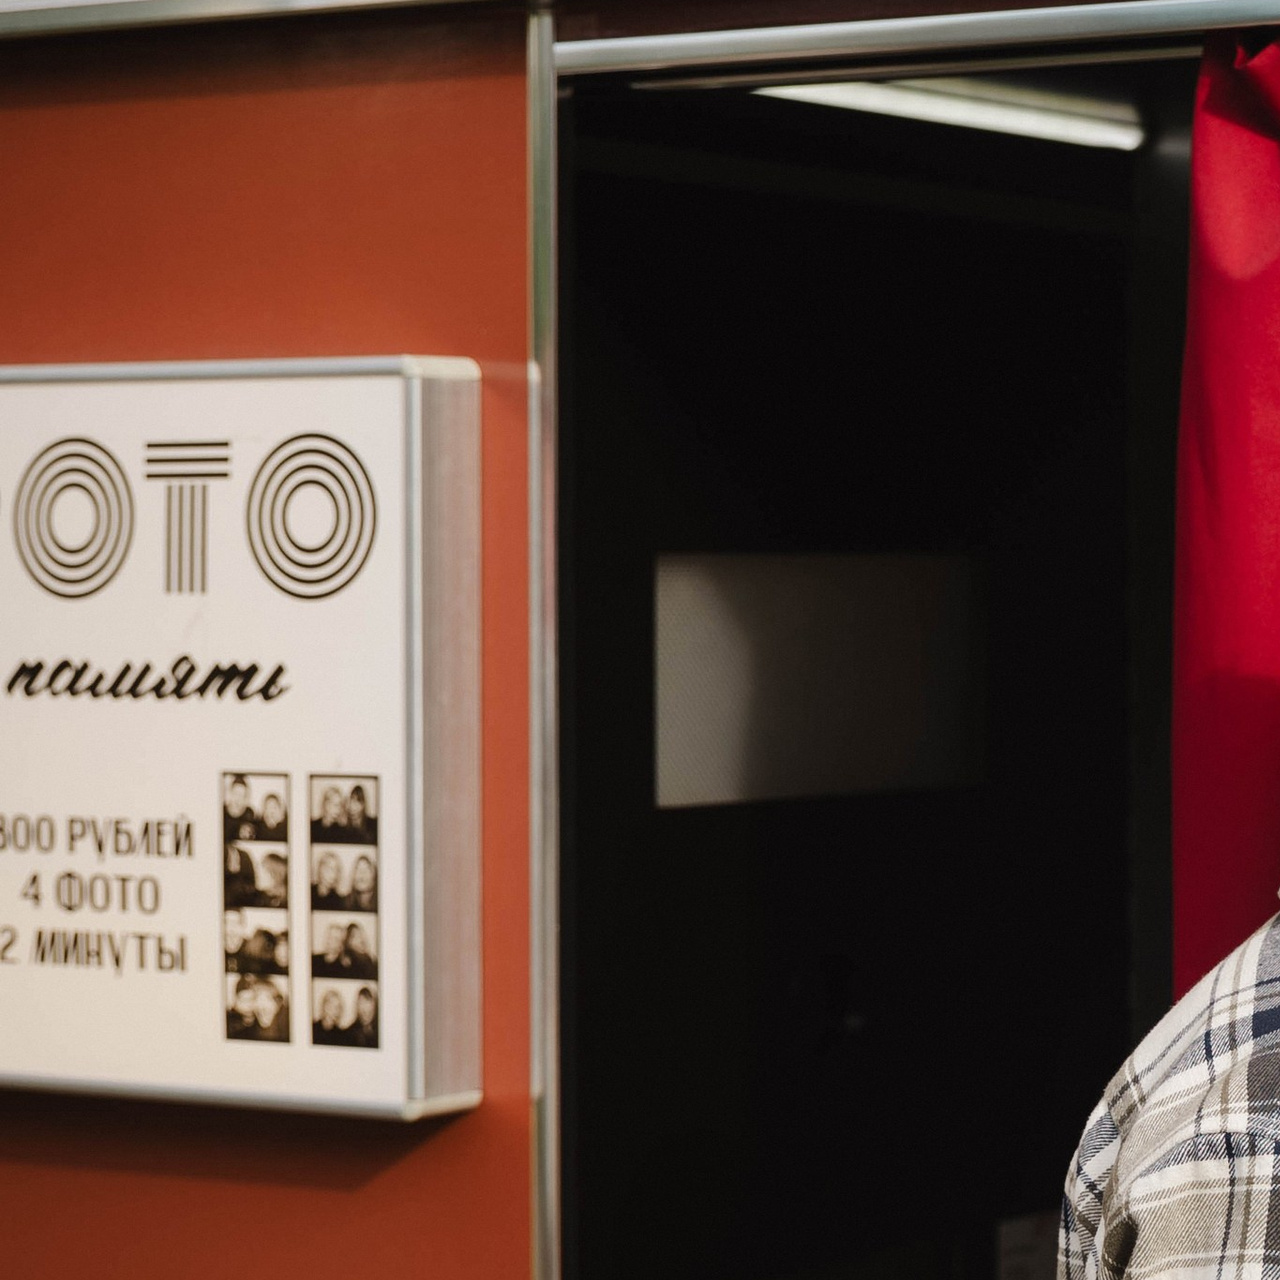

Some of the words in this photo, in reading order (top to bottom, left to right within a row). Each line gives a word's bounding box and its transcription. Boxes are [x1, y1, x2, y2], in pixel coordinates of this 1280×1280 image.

[6, 654, 289, 702] память
[67, 814, 193, 861] РУБЛЕЙ
[22, 872, 41, 908] 4
[55, 871, 161, 915] ФОТО
[0, 925, 19, 964] 2
[34, 929, 188, 976] МИНУТЫ
